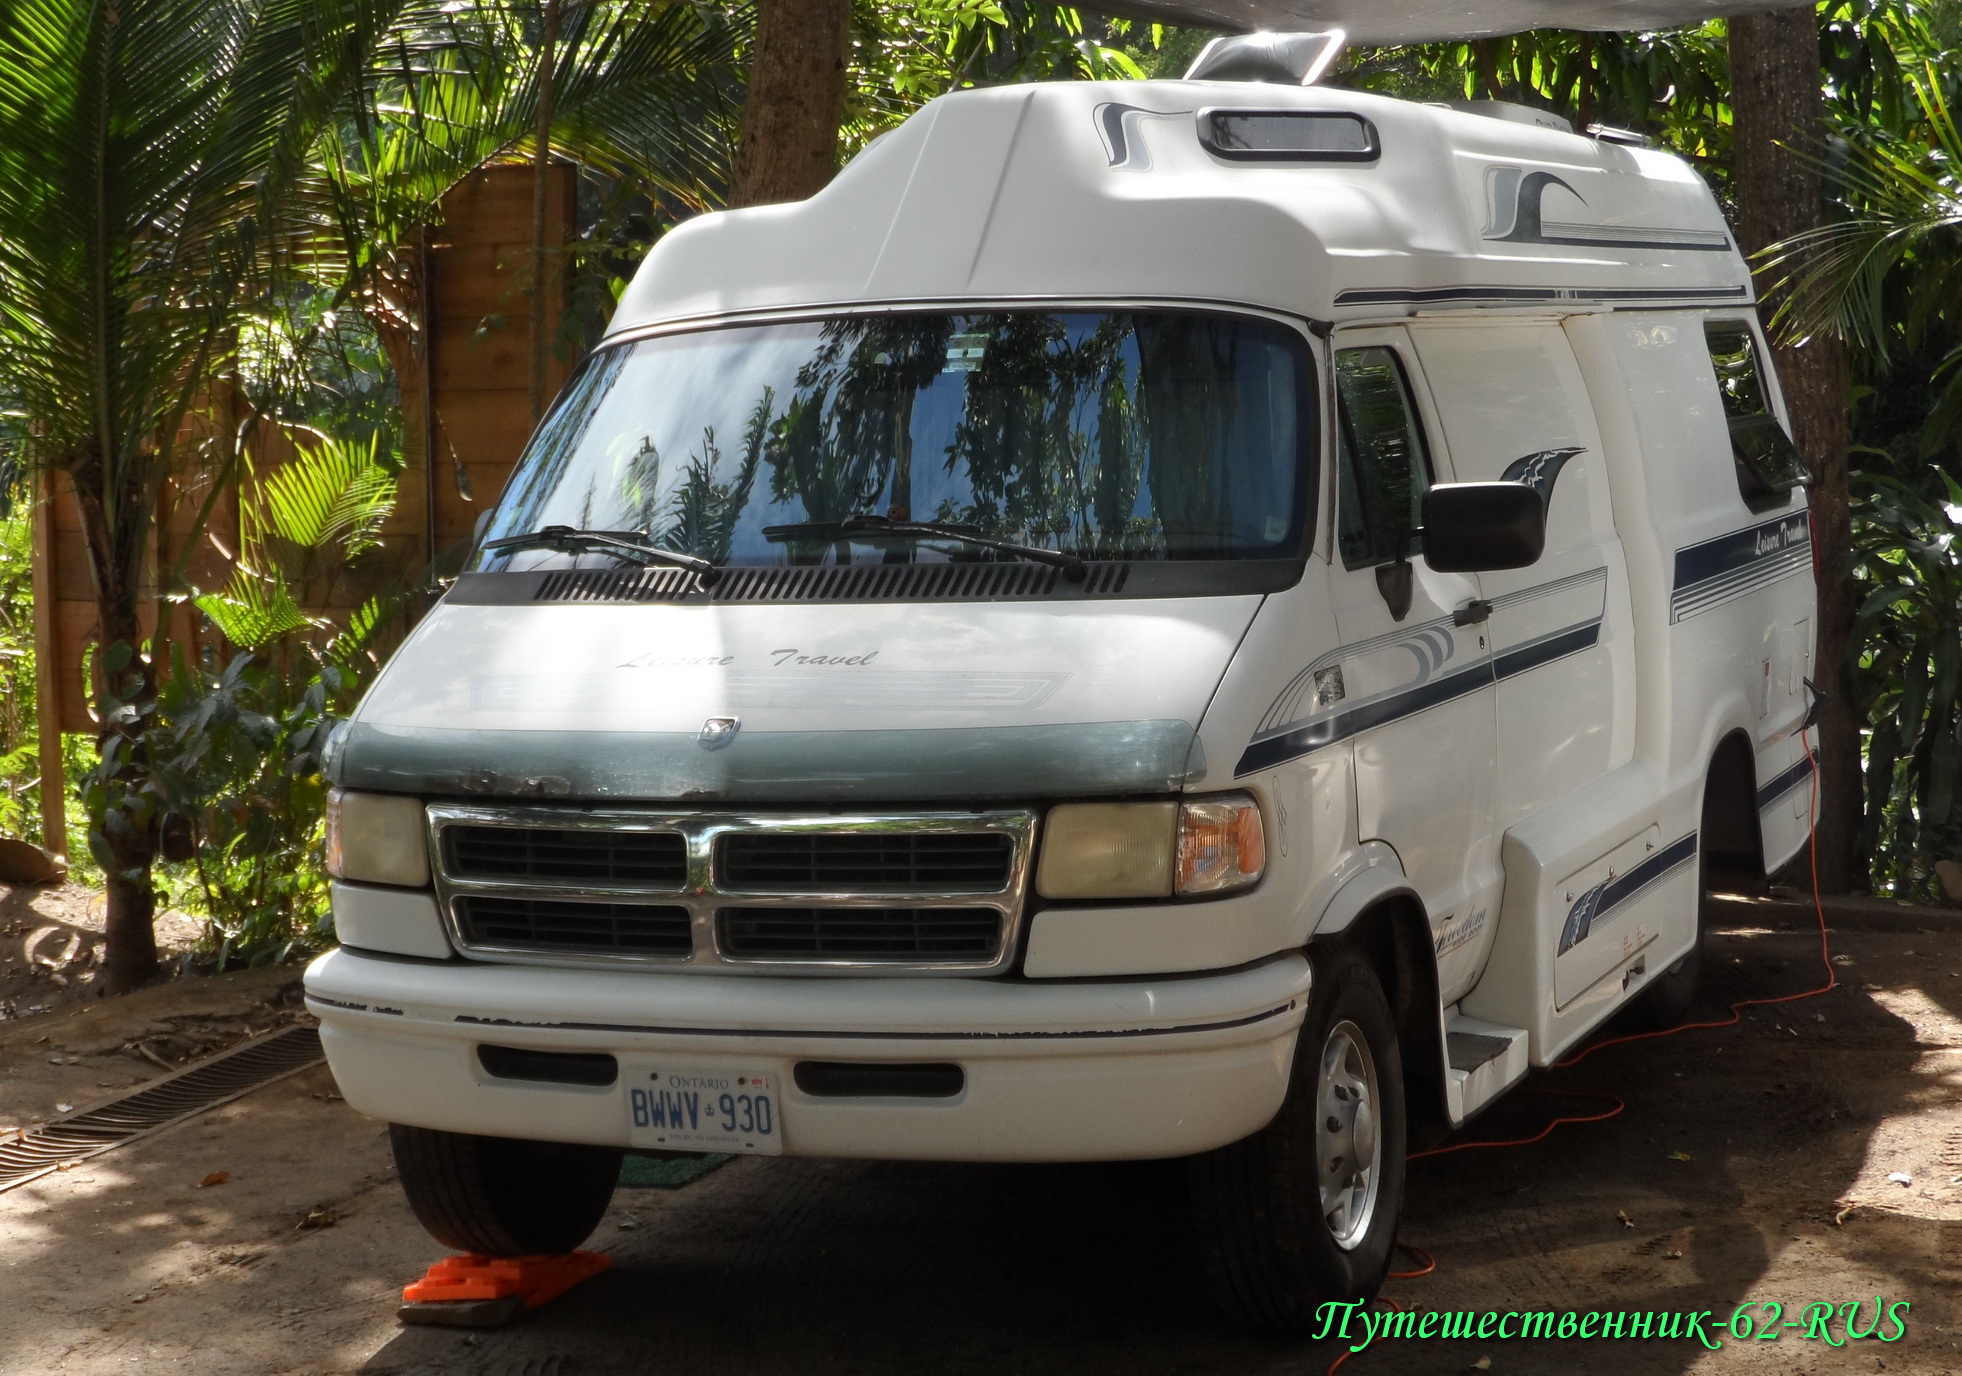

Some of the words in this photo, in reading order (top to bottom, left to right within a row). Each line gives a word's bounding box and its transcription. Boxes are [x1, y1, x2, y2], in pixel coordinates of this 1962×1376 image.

[770, 649, 879, 667] Travel
[669, 1076, 729, 1090] ONTARIO
[631, 1089, 698, 1130] BWWV
[719, 1093, 772, 1135] 930
